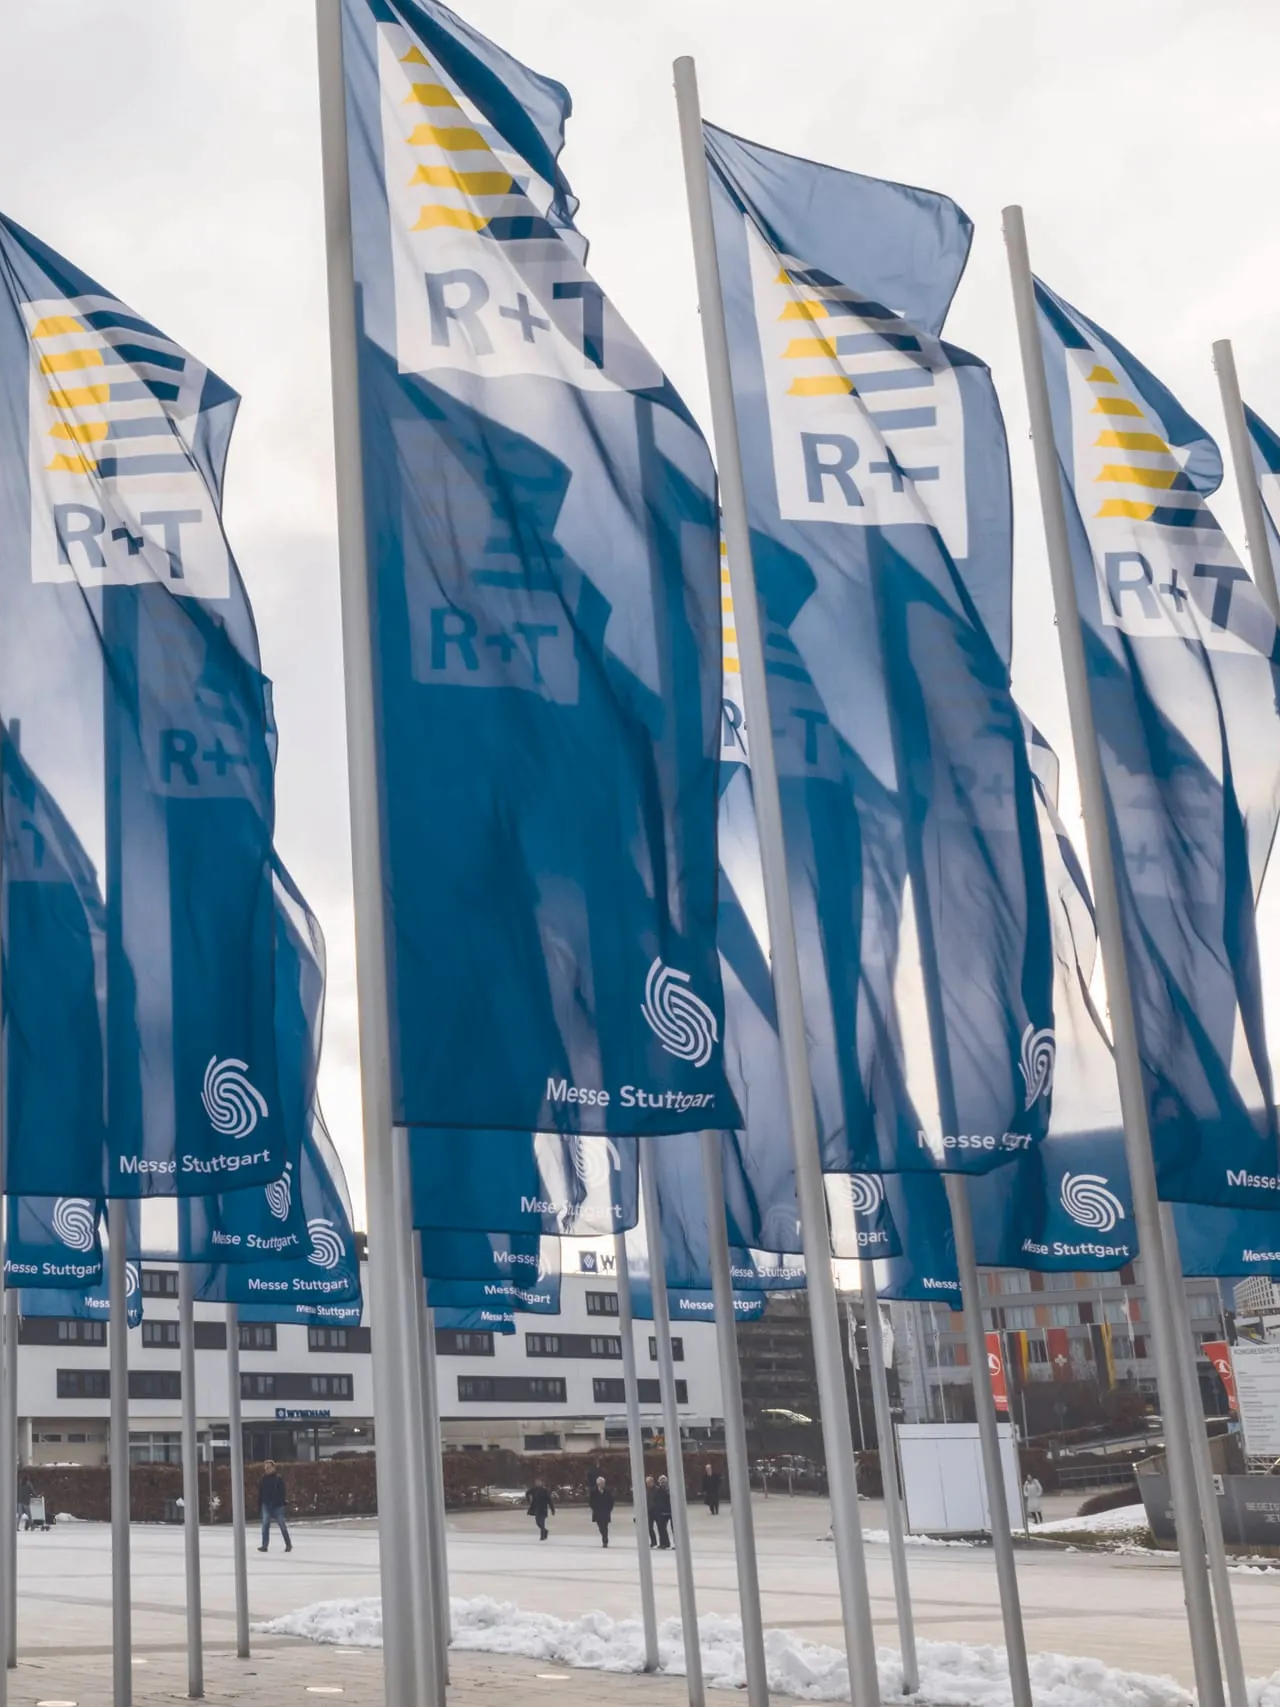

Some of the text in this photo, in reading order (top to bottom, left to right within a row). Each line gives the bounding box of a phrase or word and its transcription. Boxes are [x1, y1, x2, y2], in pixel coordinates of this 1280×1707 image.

[424, 268, 604, 370] R+T
[800, 431, 940, 507] R+
[54, 503, 203, 580] R+T
[1104, 551, 1254, 633] R+T
[546, 1077, 715, 1112] Messe Stuttgar
[917, 1130, 995, 1149] Messe
[120, 1149, 270, 1174] Messe Stuttgart
[1226, 1169, 1276, 1189] Messe
[212, 1231, 299, 1251] Messe Stuttgart
[1022, 1238, 1129, 1258] Messe Stuttgart
[493, 1251, 535, 1265] Messe
[1242, 1249, 1280, 1262] Messe
[248, 1278, 349, 1293] Messe Stuttgart
[923, 1278, 957, 1290] Messe
[85, 1297, 110, 1308] Mess
[317, 1305, 360, 1319] Stuttgart
[680, 1299, 762, 1313] Messe ttgart
